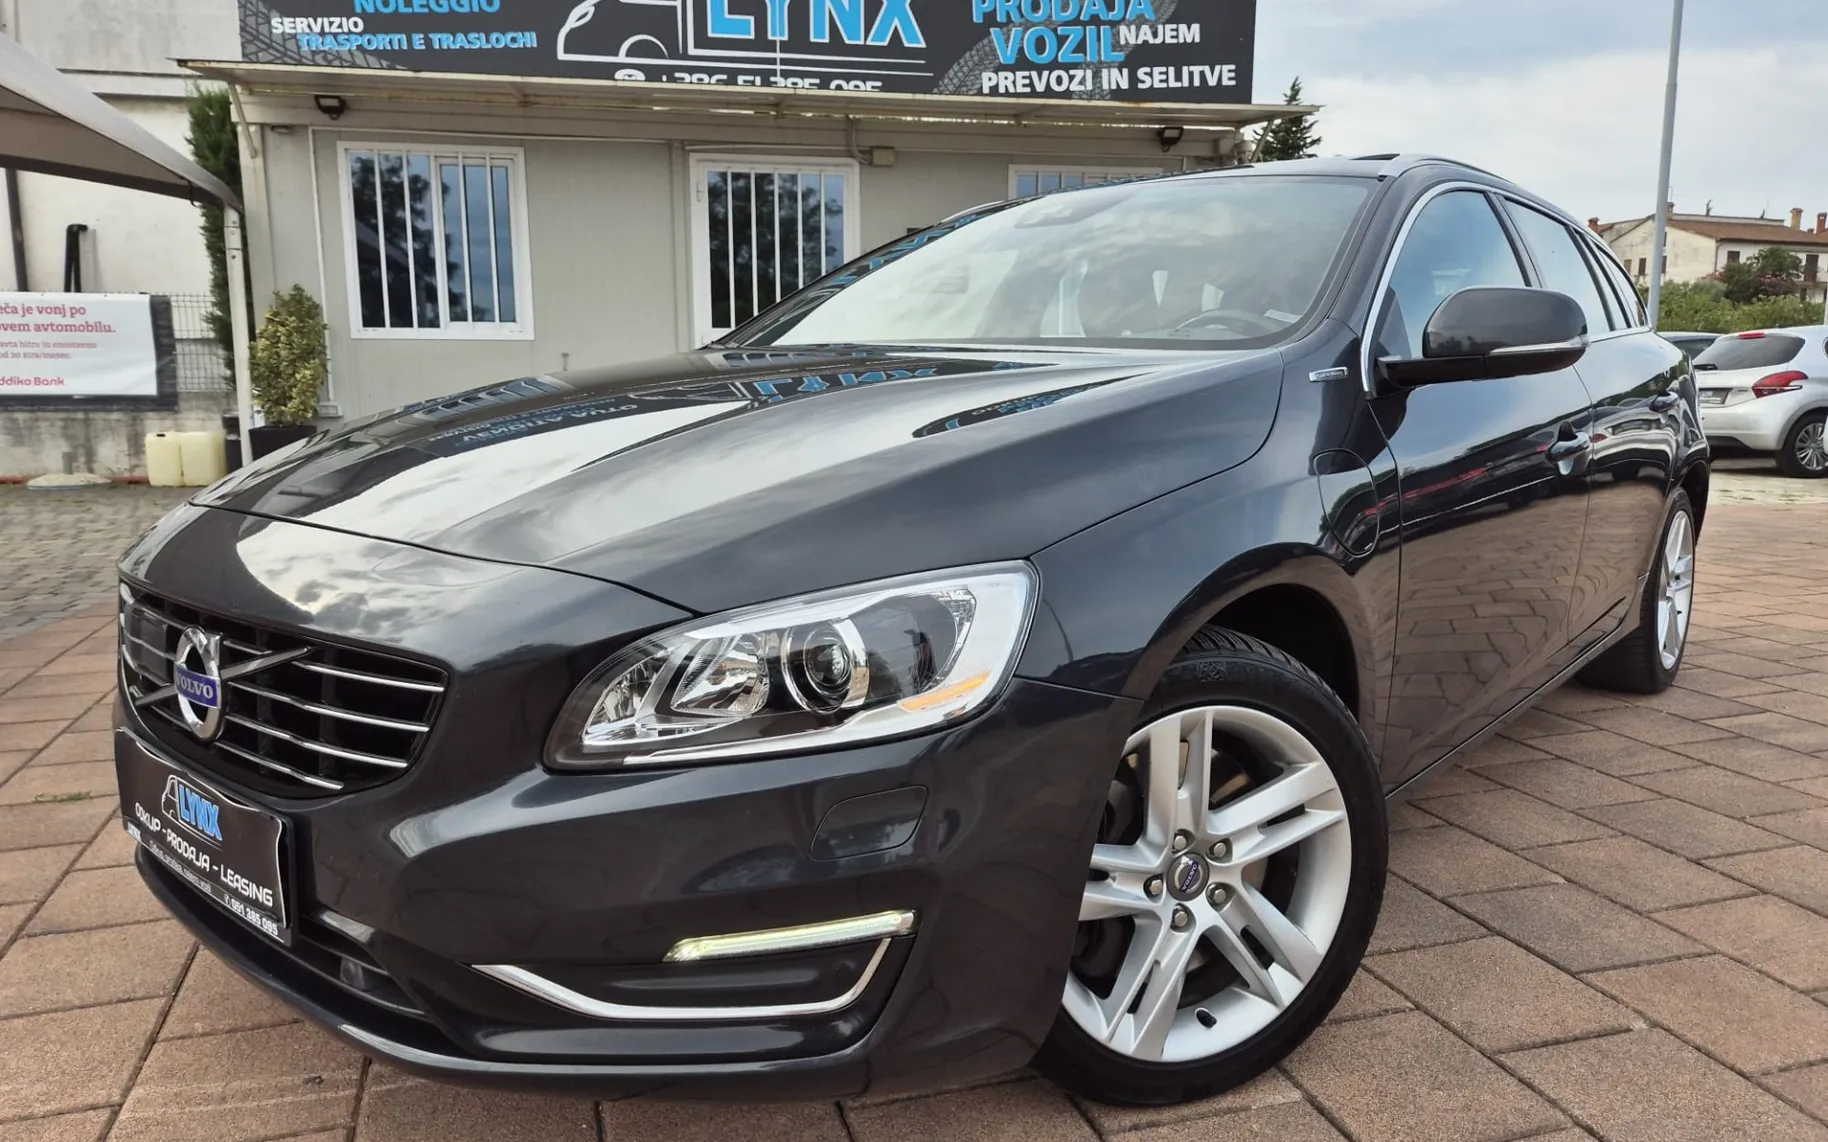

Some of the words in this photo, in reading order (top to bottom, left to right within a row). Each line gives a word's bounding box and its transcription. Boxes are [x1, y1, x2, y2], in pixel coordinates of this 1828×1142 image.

[355, 0, 500, 13] NOLEGGIO
[972, 0, 1155, 23] PRODAJA
[271, 17, 364, 34] SERVIZIO
[1119, 23, 1200, 45] NAJEM
[297, 33, 407, 50] TRASPORTI
[412, 33, 426, 49] E
[429, 31, 537, 49] TRASLOCHI
[990, 25, 1124, 64] VOZIL
[981, 69, 1093, 94] PREVOZI
[1102, 67, 1129, 90] IN
[1137, 64, 1237, 90] SELITVE
[21, 304, 33, 318] je
[37, 304, 66, 318] vonj
[69, 306, 87, 319] po
[33, 321, 116, 333] avtomobilu.
[34, 376, 65, 386] Bank
[176, 672, 214, 700] VOLVO
[178, 783, 223, 841] LYNX
[166, 828, 210, 872] PRODAJA
[220, 864, 273, 908] LEASING
[1182, 863, 1199, 891] VOLVO
